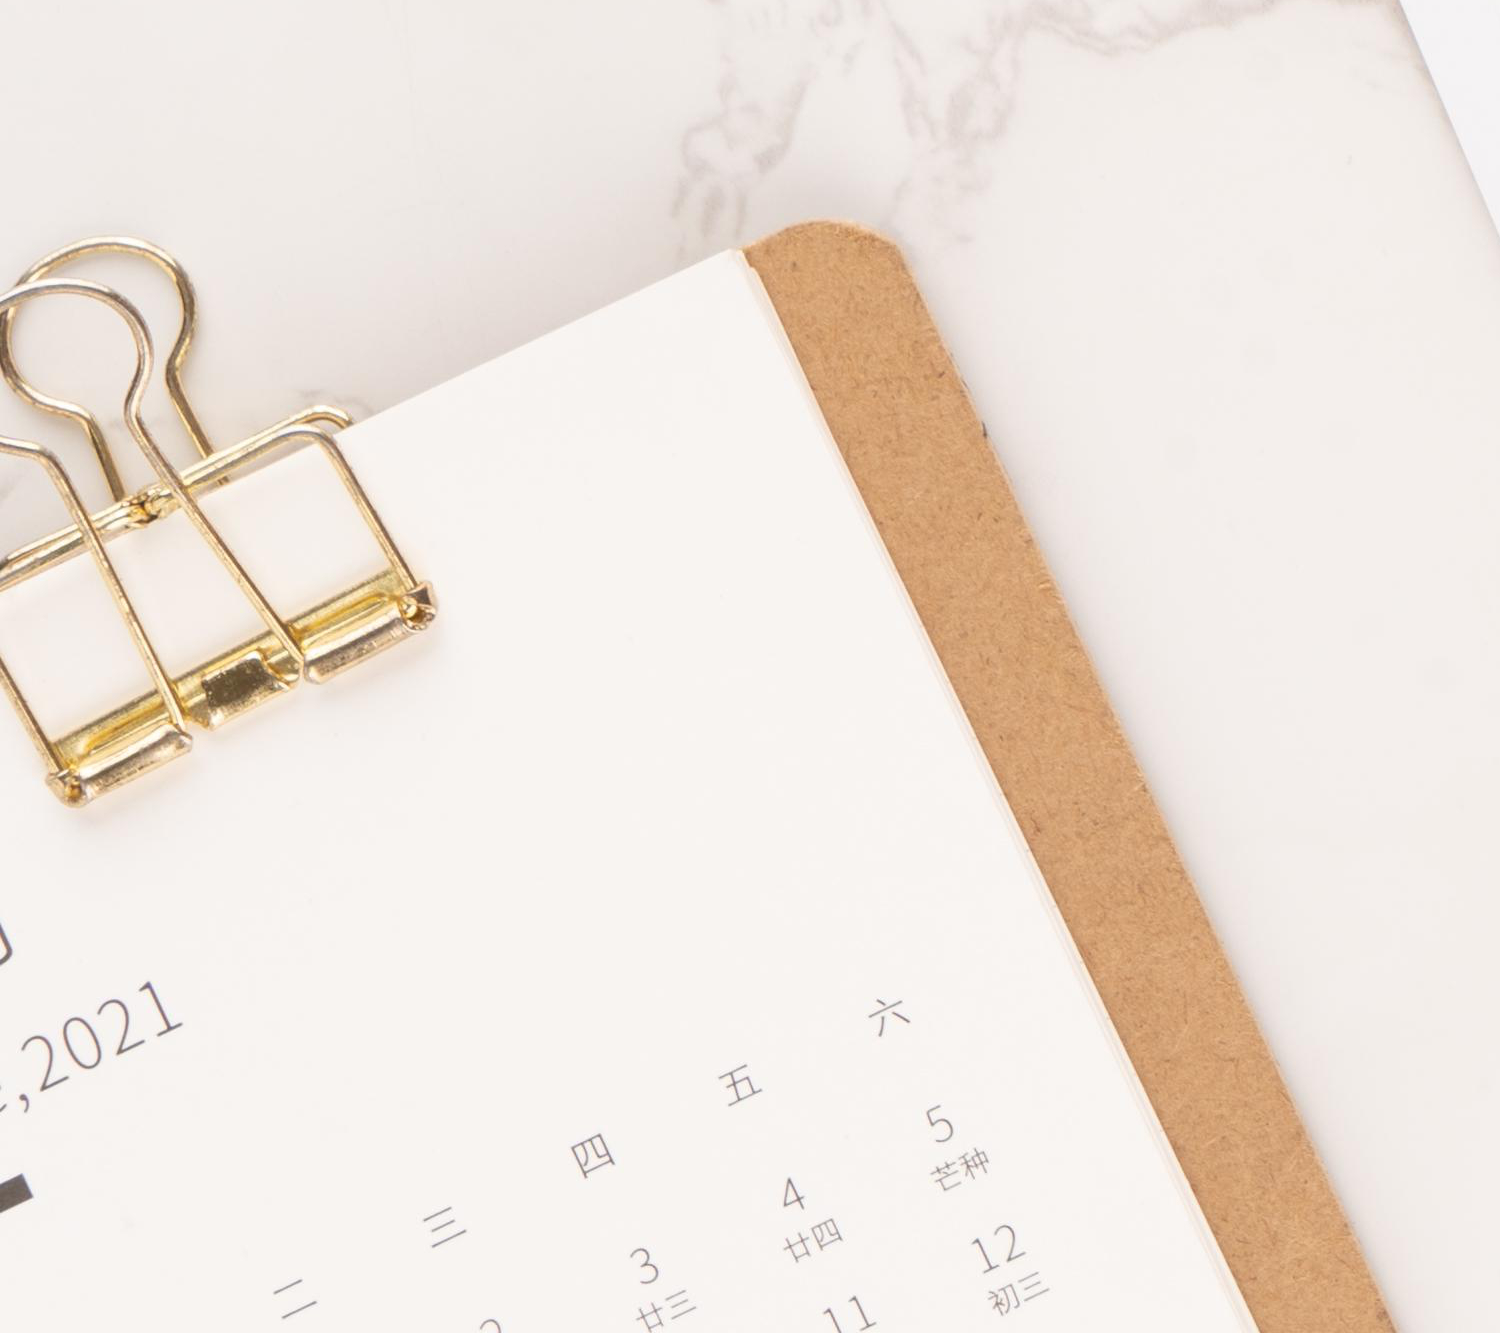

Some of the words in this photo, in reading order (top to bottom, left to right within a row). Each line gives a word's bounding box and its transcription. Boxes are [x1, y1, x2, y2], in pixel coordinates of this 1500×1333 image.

[868, 998, 910, 1037] 六
[719, 1064, 762, 1106] 五
[926, 1104, 954, 1142] 5
[571, 1133, 616, 1178] 四
[931, 1147, 991, 1191] 芒种
[783, 1176, 805, 1211] 4
[423, 1207, 467, 1248] 三
[783, 1217, 843, 1263] 廿四
[629, 1247, 659, 1284] 3
[971, 1224, 1026, 1274] 12
[273, 1279, 317, 1319] 二
[988, 1271, 1050, 1316] 初三
